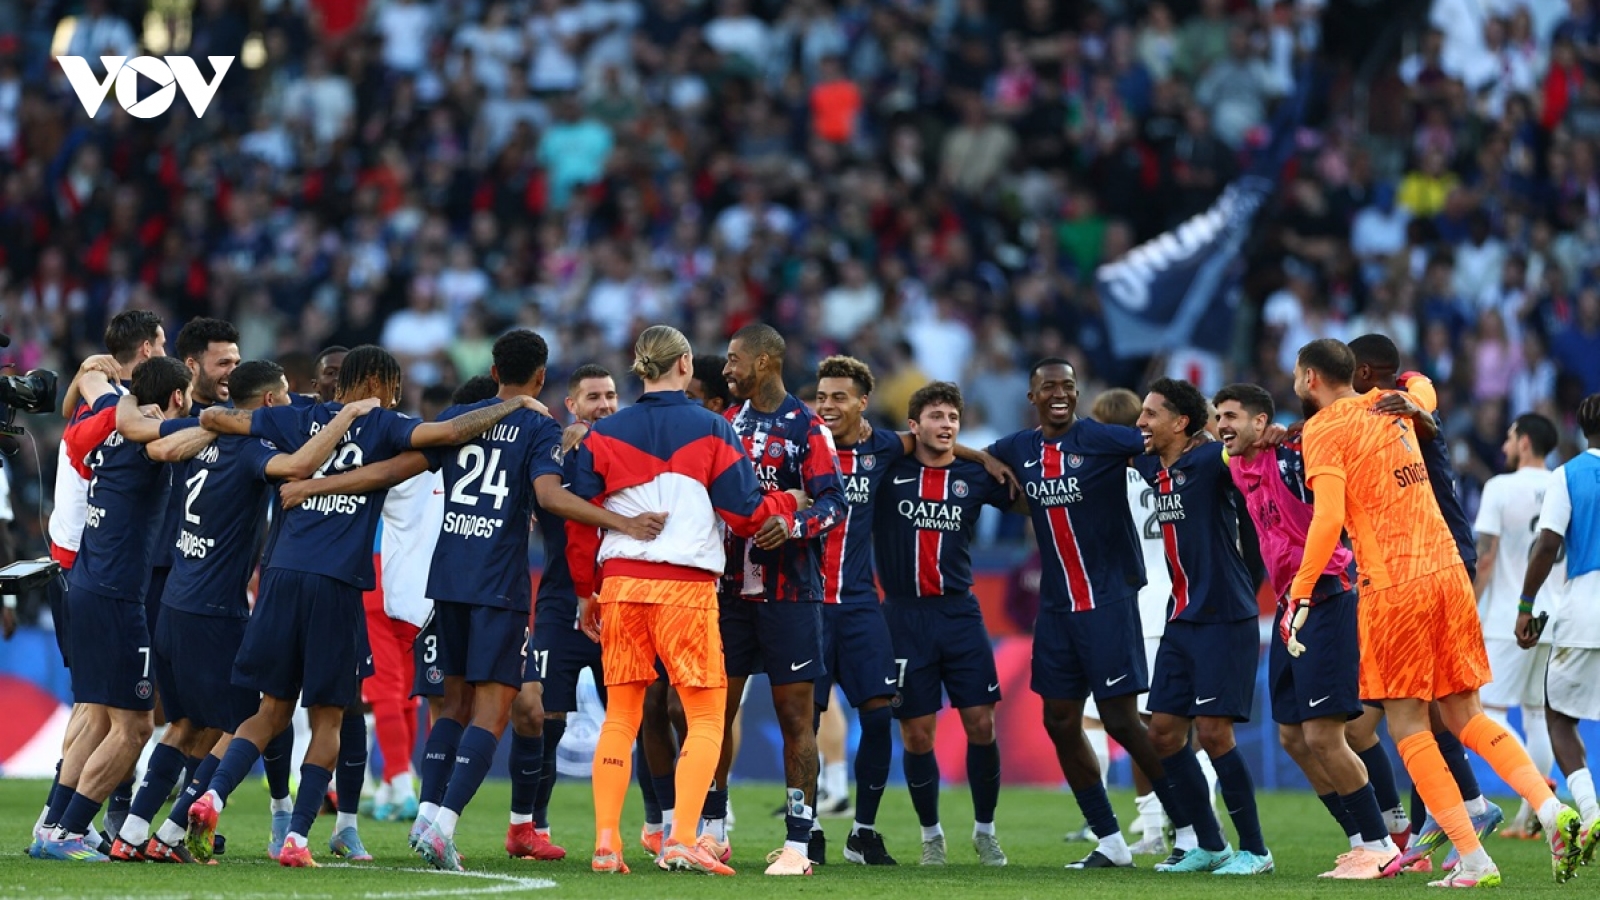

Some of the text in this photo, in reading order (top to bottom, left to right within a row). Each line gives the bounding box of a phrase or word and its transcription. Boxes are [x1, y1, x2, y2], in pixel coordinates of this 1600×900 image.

[450, 443, 510, 510] 24
[1026, 476, 1081, 500] QATAR
[185, 468, 209, 525] 2
[1040, 491, 1084, 507] AIRWAYS
[1158, 493, 1184, 511] ATAR
[898, 499, 963, 521] QATAR
[443, 511, 496, 540] snipes
[912, 517, 961, 532] AIRWAYS
[138, 646, 150, 678] 7
[423, 634, 438, 664] 3
